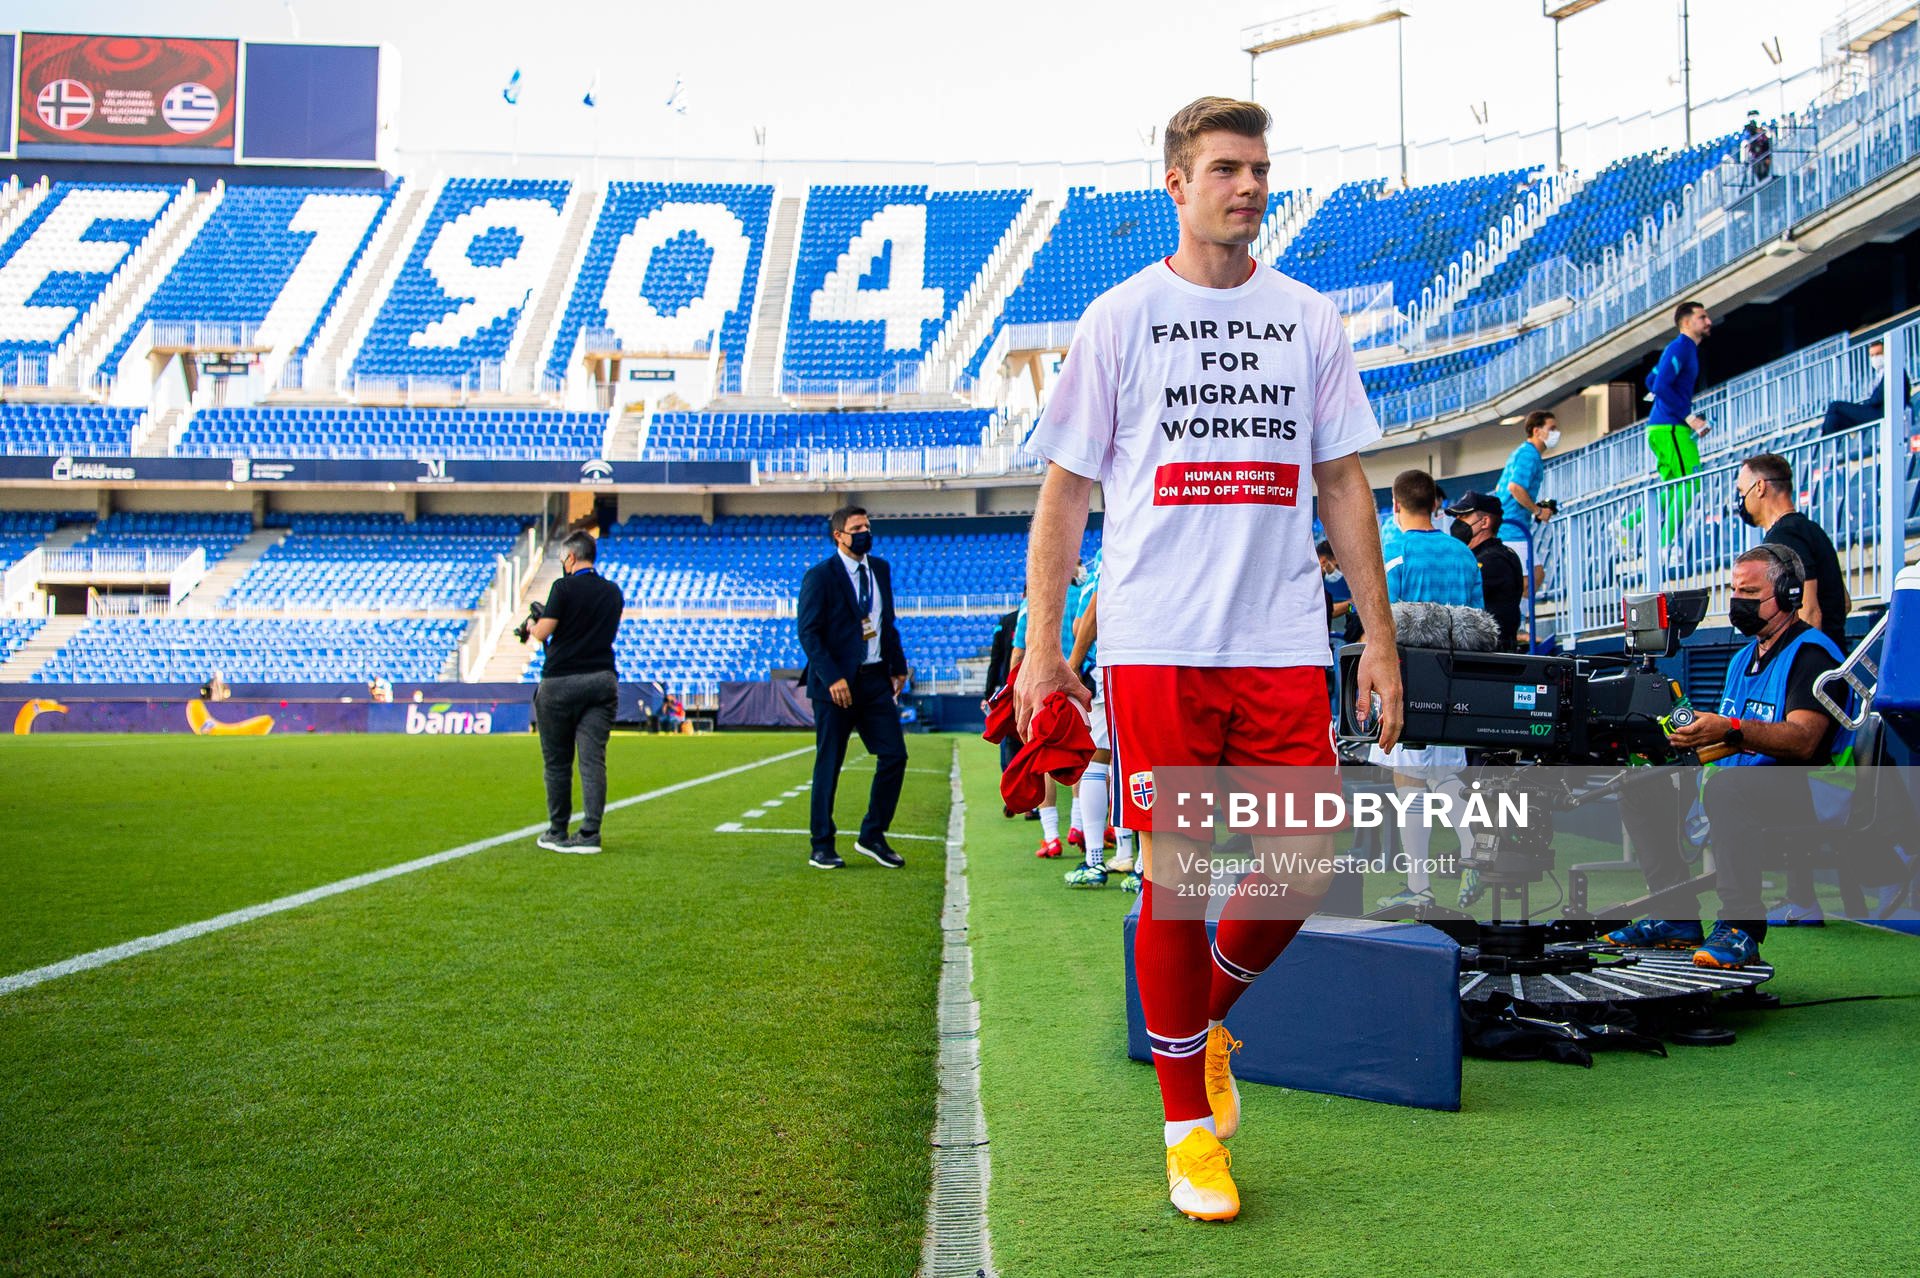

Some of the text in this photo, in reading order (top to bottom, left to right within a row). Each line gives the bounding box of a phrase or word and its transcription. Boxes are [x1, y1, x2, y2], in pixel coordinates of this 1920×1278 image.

[1152, 320, 1297, 344] FAIR PLAY
[1200, 351, 1259, 372] FOR
[1165, 383, 1295, 408] MIGRANT
[1160, 417, 1297, 442] WORKERS
[1184, 470, 1275, 482] HUMAN RIGHTS
[1158, 484, 1293, 497] ON AND OFF THE PITCH
[1409, 701, 1470, 711] FUJINON 4K
[406, 703, 492, 735] bama
[1529, 724, 1552, 736] 107
